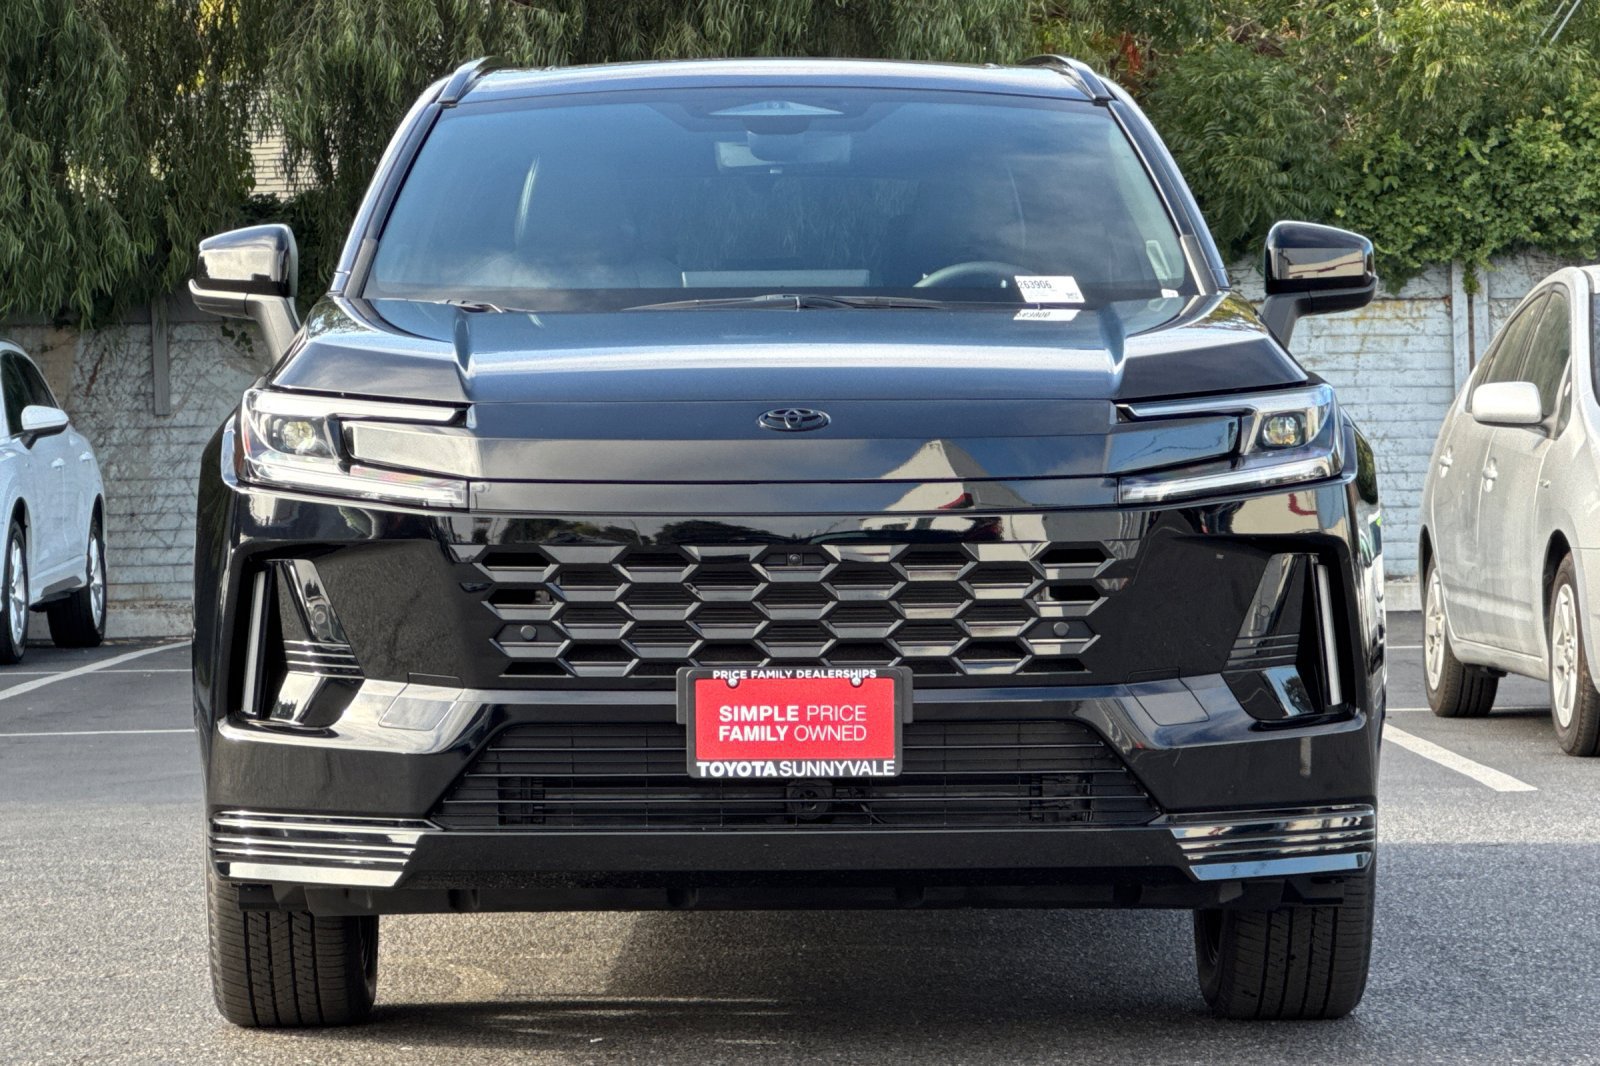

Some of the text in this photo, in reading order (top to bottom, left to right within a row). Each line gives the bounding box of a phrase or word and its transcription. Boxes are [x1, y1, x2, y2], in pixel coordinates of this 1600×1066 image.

[713, 669, 877, 680] PRICE FAMILY DEALERSHIPS
[719, 705, 867, 722] SIMPLE PRICE
[719, 725, 867, 742] FAMILY OWNED
[696, 761, 895, 777] TOYOTA SUNNYVALE
